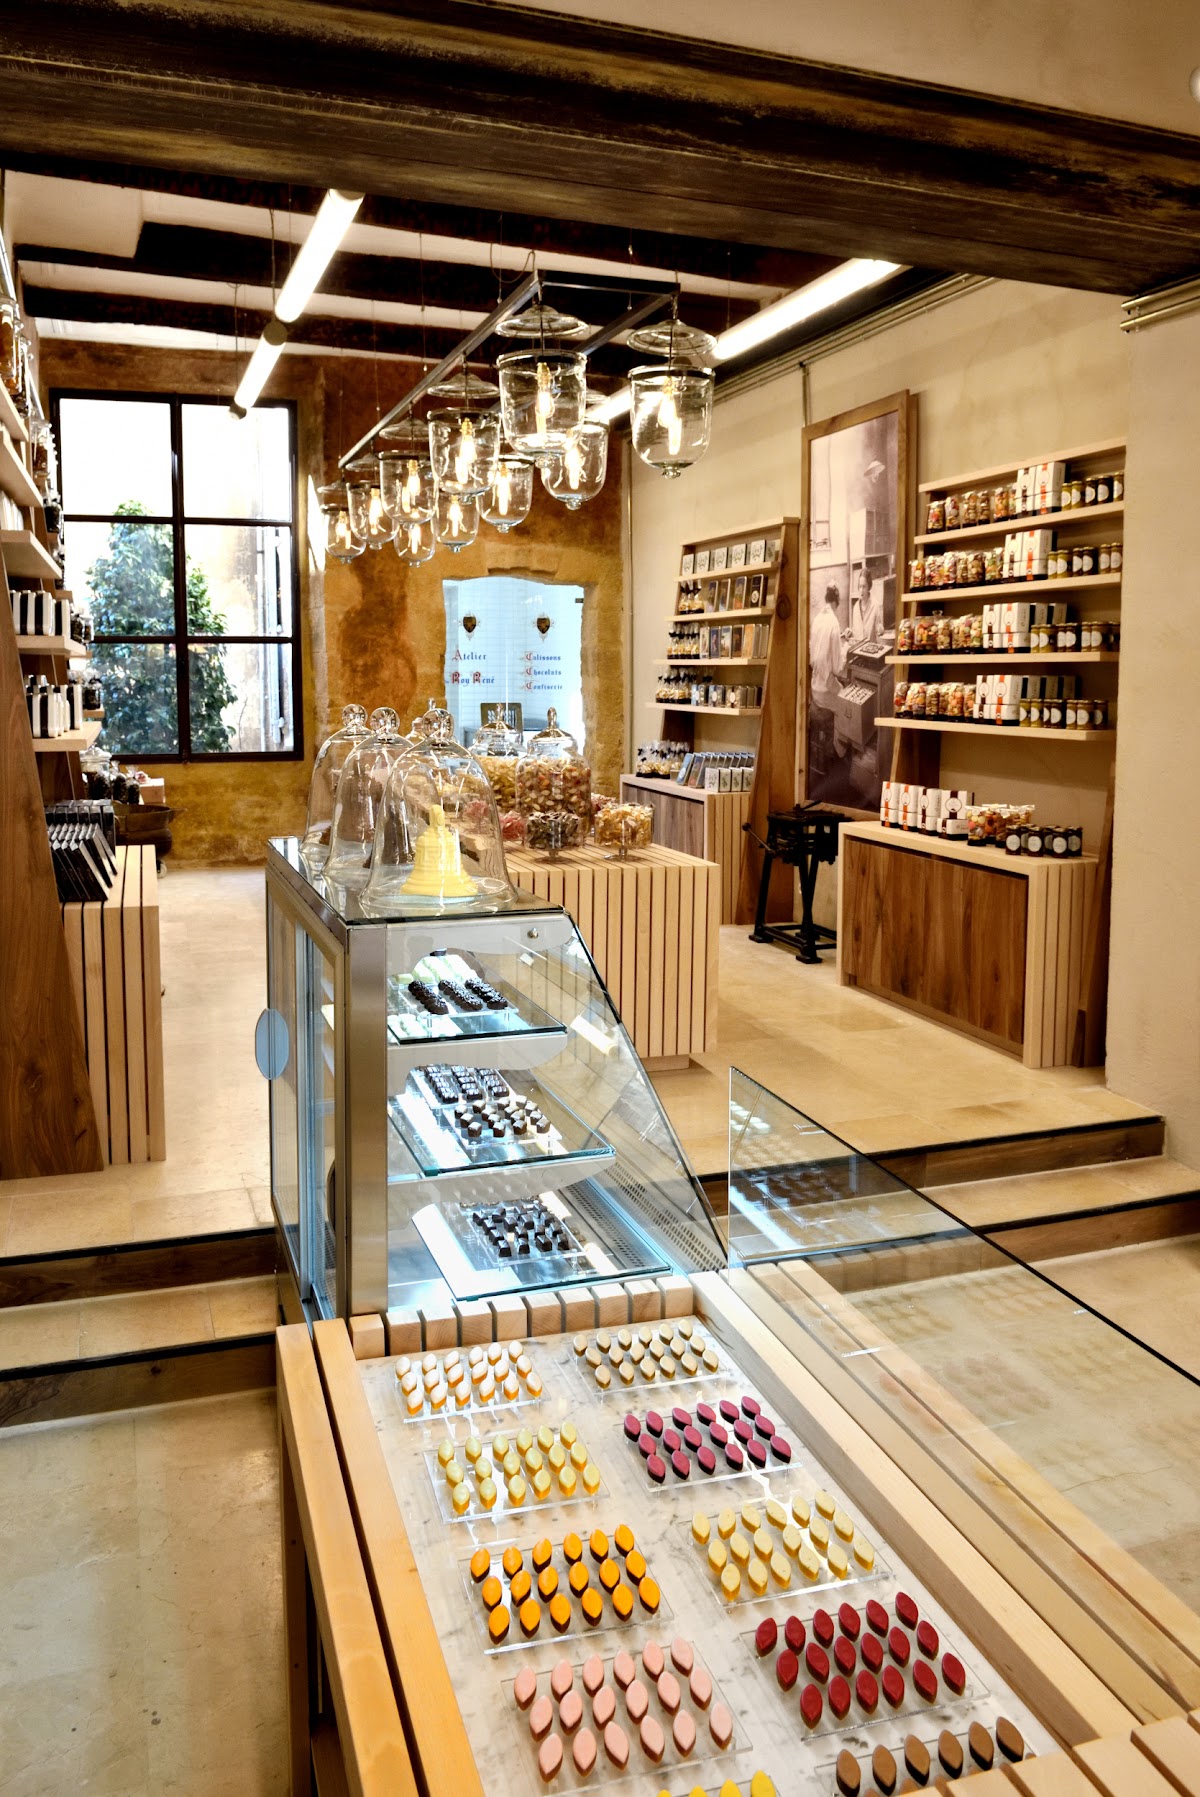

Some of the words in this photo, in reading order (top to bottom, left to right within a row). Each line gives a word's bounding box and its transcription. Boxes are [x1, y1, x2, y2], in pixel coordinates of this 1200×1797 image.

[452, 649, 487, 661] Atelier
[525, 652, 561, 661] Calissons
[525, 667, 562, 676] Chocolats
[451, 671, 470, 687] Roy
[473, 671, 495, 684] René
[525, 681, 563, 690] Confiserie
